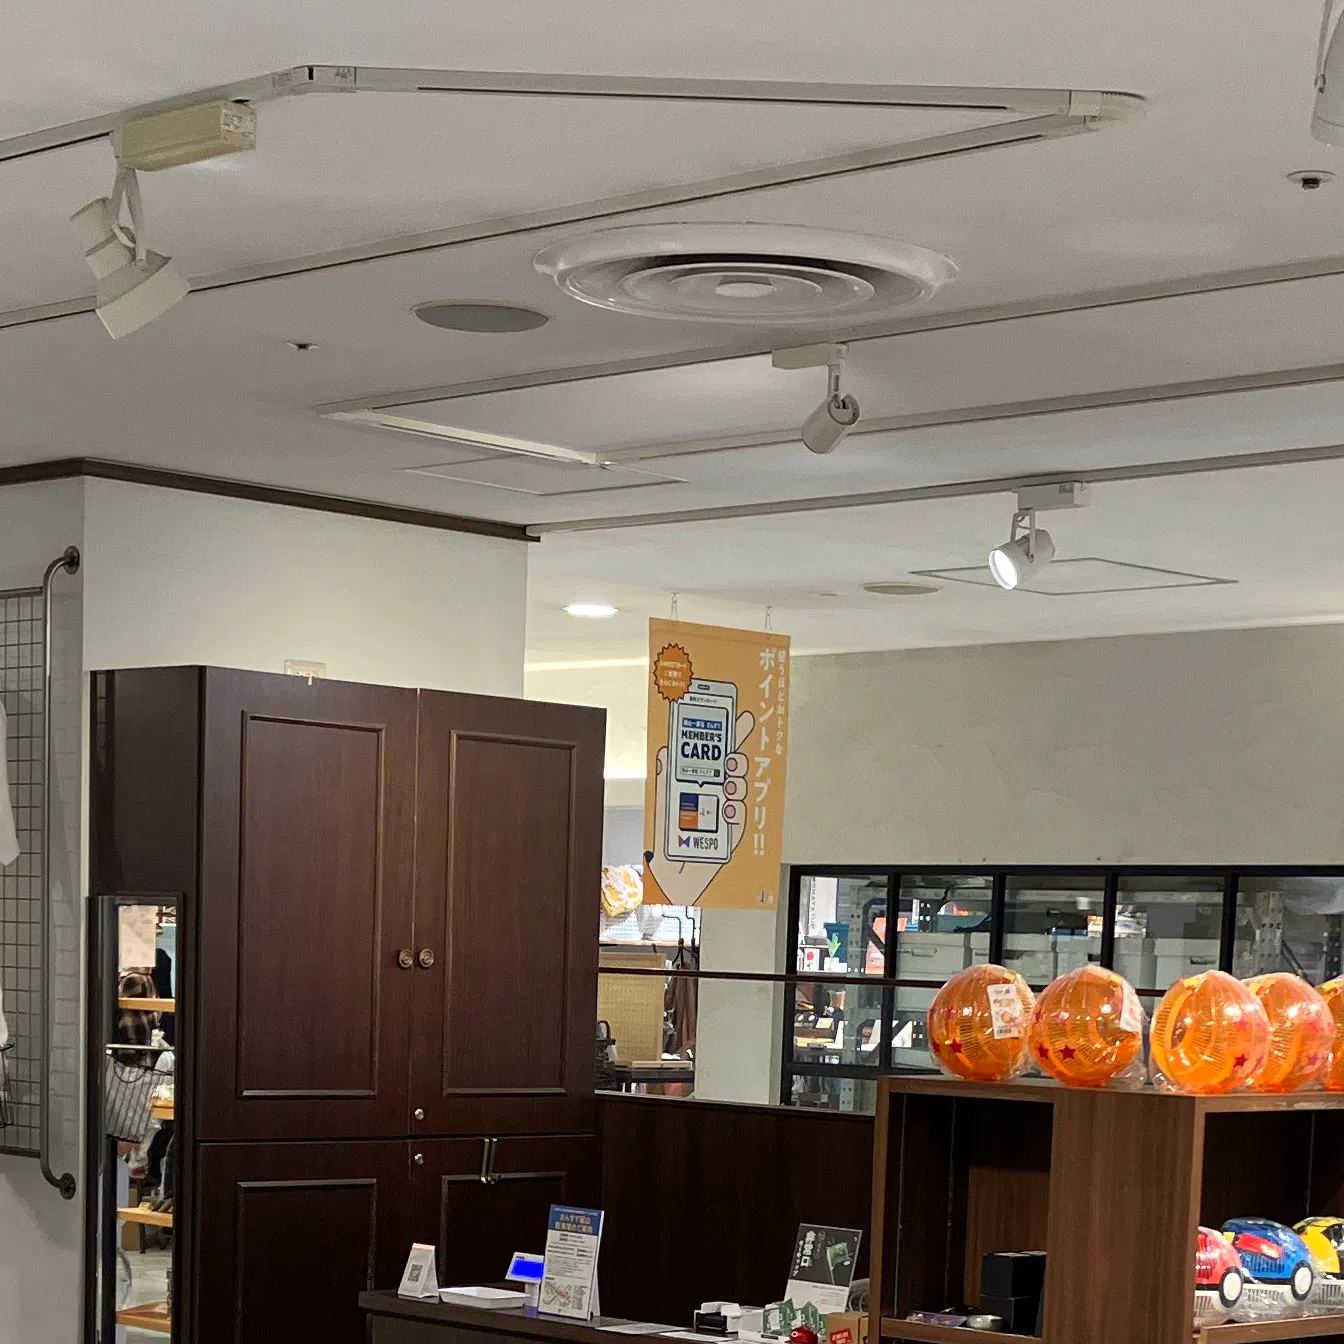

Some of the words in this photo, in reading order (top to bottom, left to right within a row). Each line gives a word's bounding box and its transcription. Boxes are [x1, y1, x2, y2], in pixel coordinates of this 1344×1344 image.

[681, 730, 722, 742] MEMBER'S
[681, 742, 722, 761] CARD
[693, 837, 718, 851] WESPO
